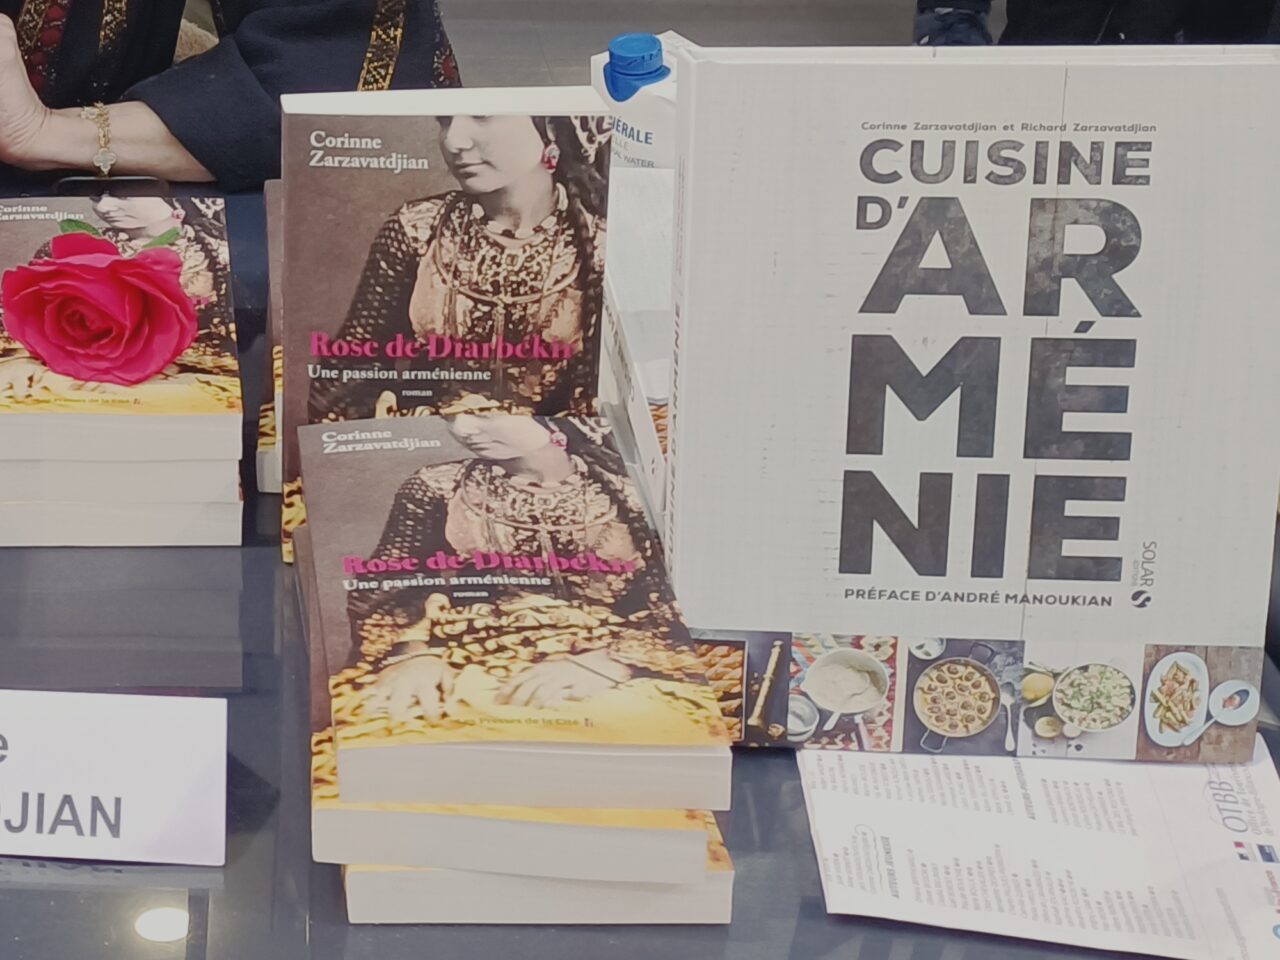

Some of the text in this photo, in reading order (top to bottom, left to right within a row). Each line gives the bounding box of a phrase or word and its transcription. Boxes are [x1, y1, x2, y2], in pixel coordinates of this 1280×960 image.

[861, 121, 1157, 134] Corinne Zarzavatdjian et Richard Zarzavatdjian
[309, 130, 382, 151] Corinne
[309, 150, 430, 172] Zarzavatdjian
[859, 137, 1153, 186] CUISINE
[309, 331, 378, 359] Rose
[385, 331, 420, 359] de
[307, 364, 492, 382] Une passion arménienne
[401, 388, 433, 398] roman
[845, 320, 1137, 461] MÉ
[321, 428, 393, 442] Corinne
[323, 436, 442, 455] Zarzavatdjian
[838, 469, 1127, 582] NIE
[1140, 541, 1157, 588] SOLAR
[343, 572, 552, 591] Une passion arménienne
[844, 587, 1113, 607] PRÉFACE D'ANDRÉ MANOUKIAN
[1207, 780, 1249, 833] OTBB
